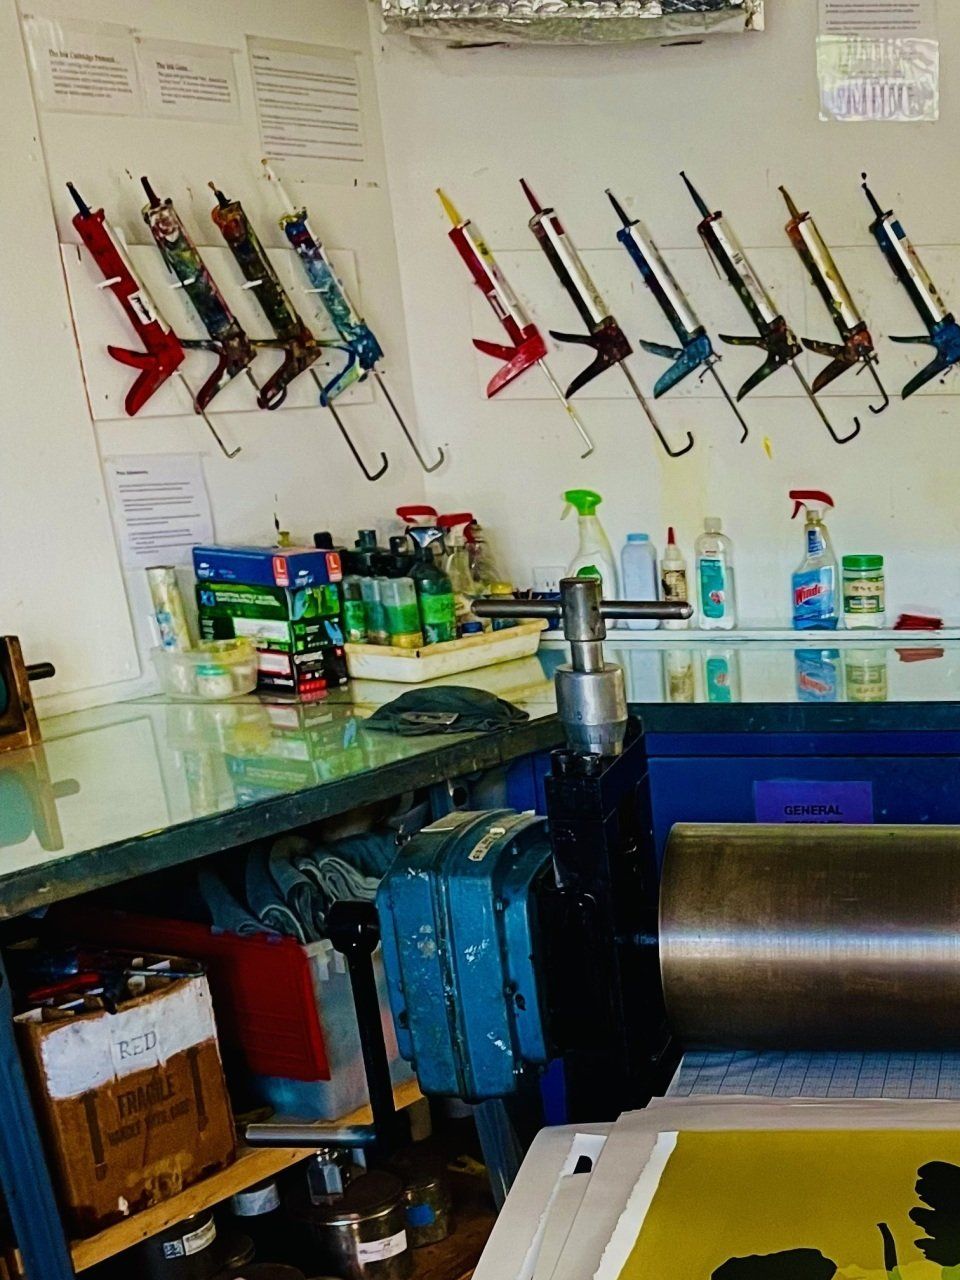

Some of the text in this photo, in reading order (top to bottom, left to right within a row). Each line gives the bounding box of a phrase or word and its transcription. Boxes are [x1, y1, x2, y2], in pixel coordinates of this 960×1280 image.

[784, 805, 843, 816] GENERAL
[115, 1030, 157, 1059] RED
[117, 1073, 176, 1119] FRAGILE
